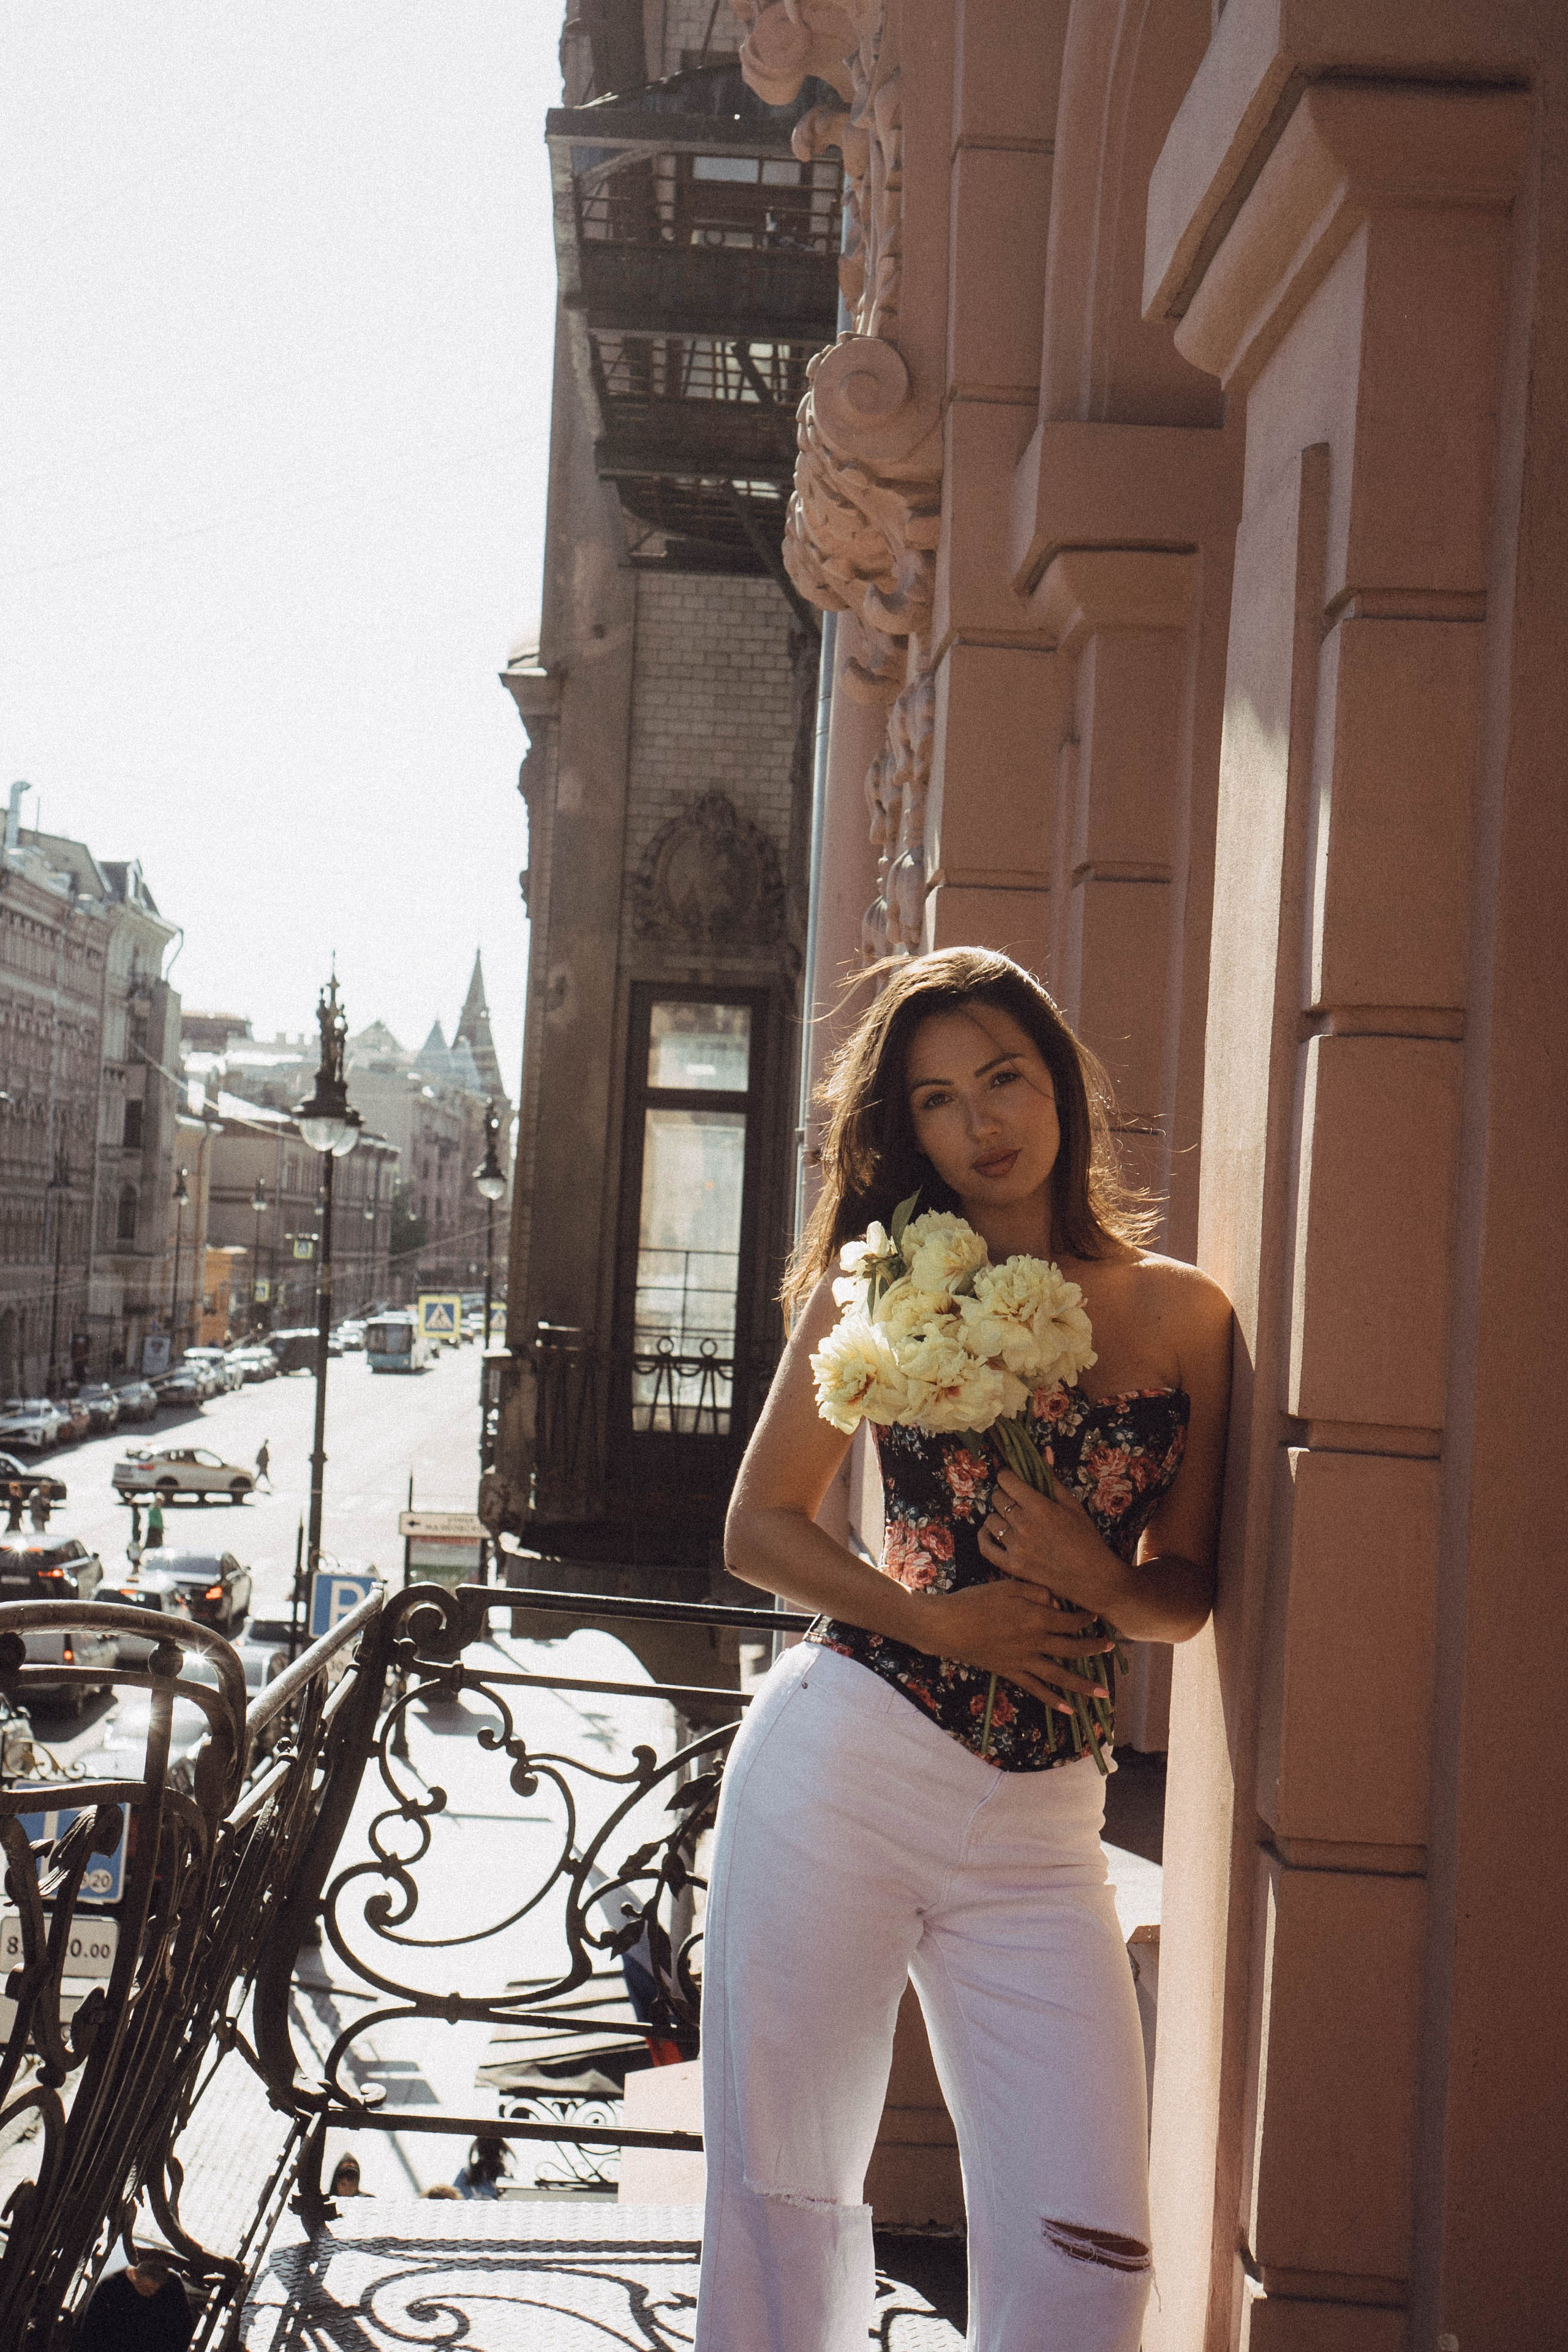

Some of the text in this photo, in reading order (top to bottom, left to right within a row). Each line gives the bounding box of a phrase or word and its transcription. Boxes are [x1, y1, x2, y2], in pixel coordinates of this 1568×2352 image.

[329, 1581, 366, 1632] P
[92, 1874, 110, 1888] 20
[70, 1939, 110, 1959] 0.00
